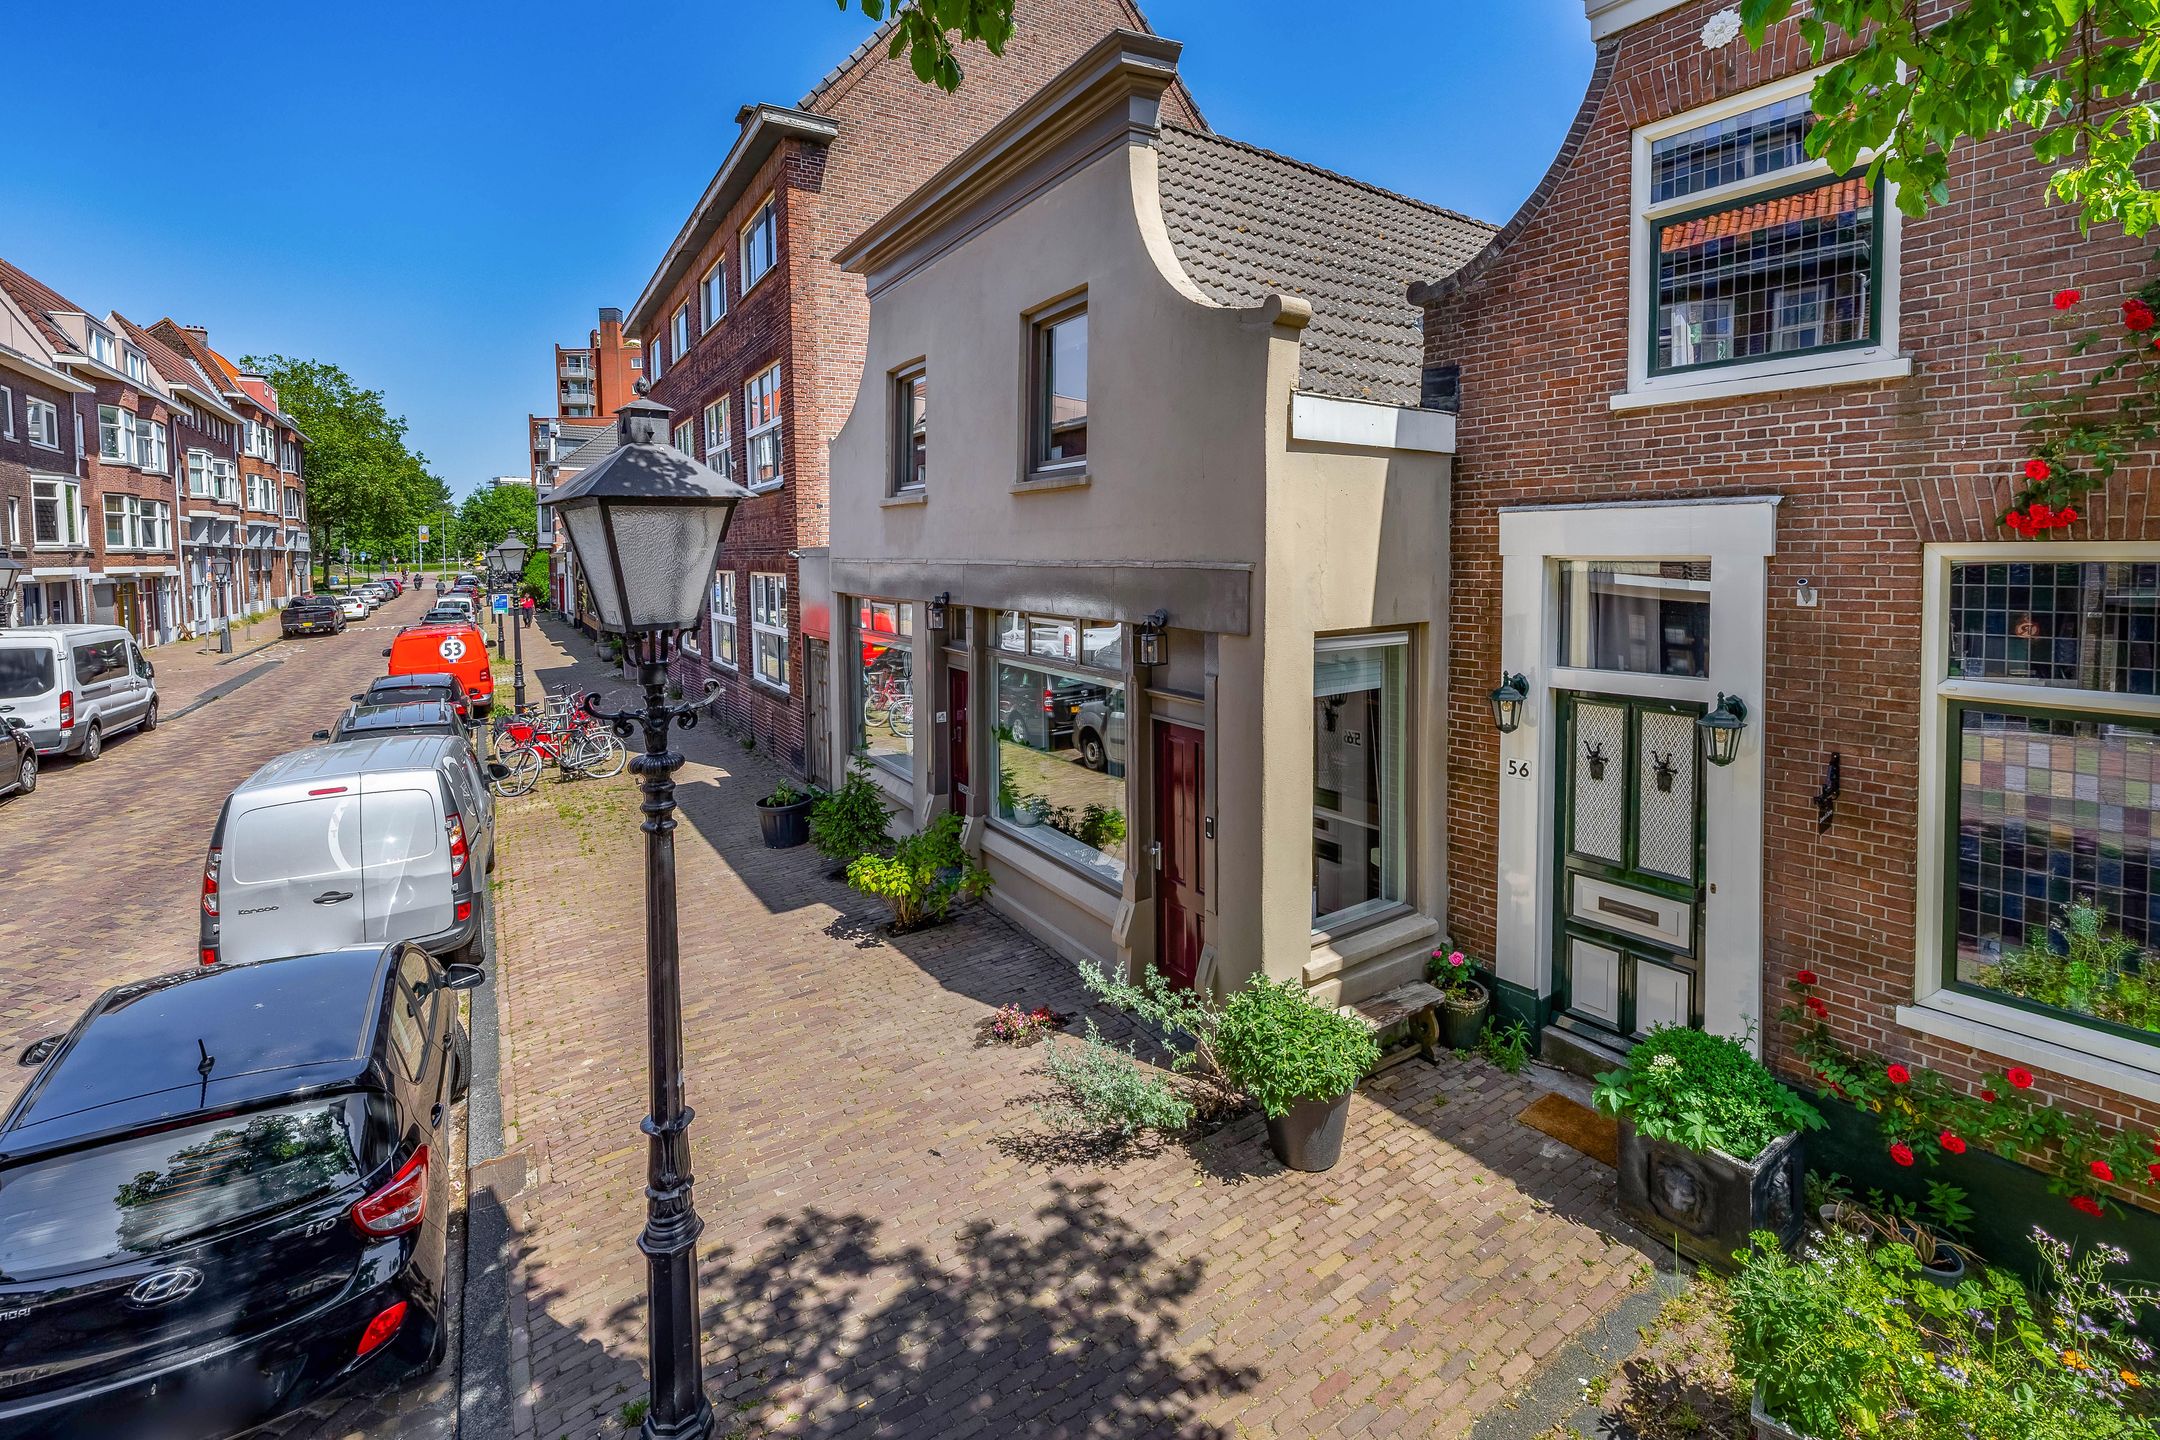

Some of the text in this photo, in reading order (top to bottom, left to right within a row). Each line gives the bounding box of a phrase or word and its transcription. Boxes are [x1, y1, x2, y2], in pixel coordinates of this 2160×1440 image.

[444, 642, 462, 657] 53
[1508, 760, 1529, 777] 56
[238, 905, 280, 916] Kangoo
